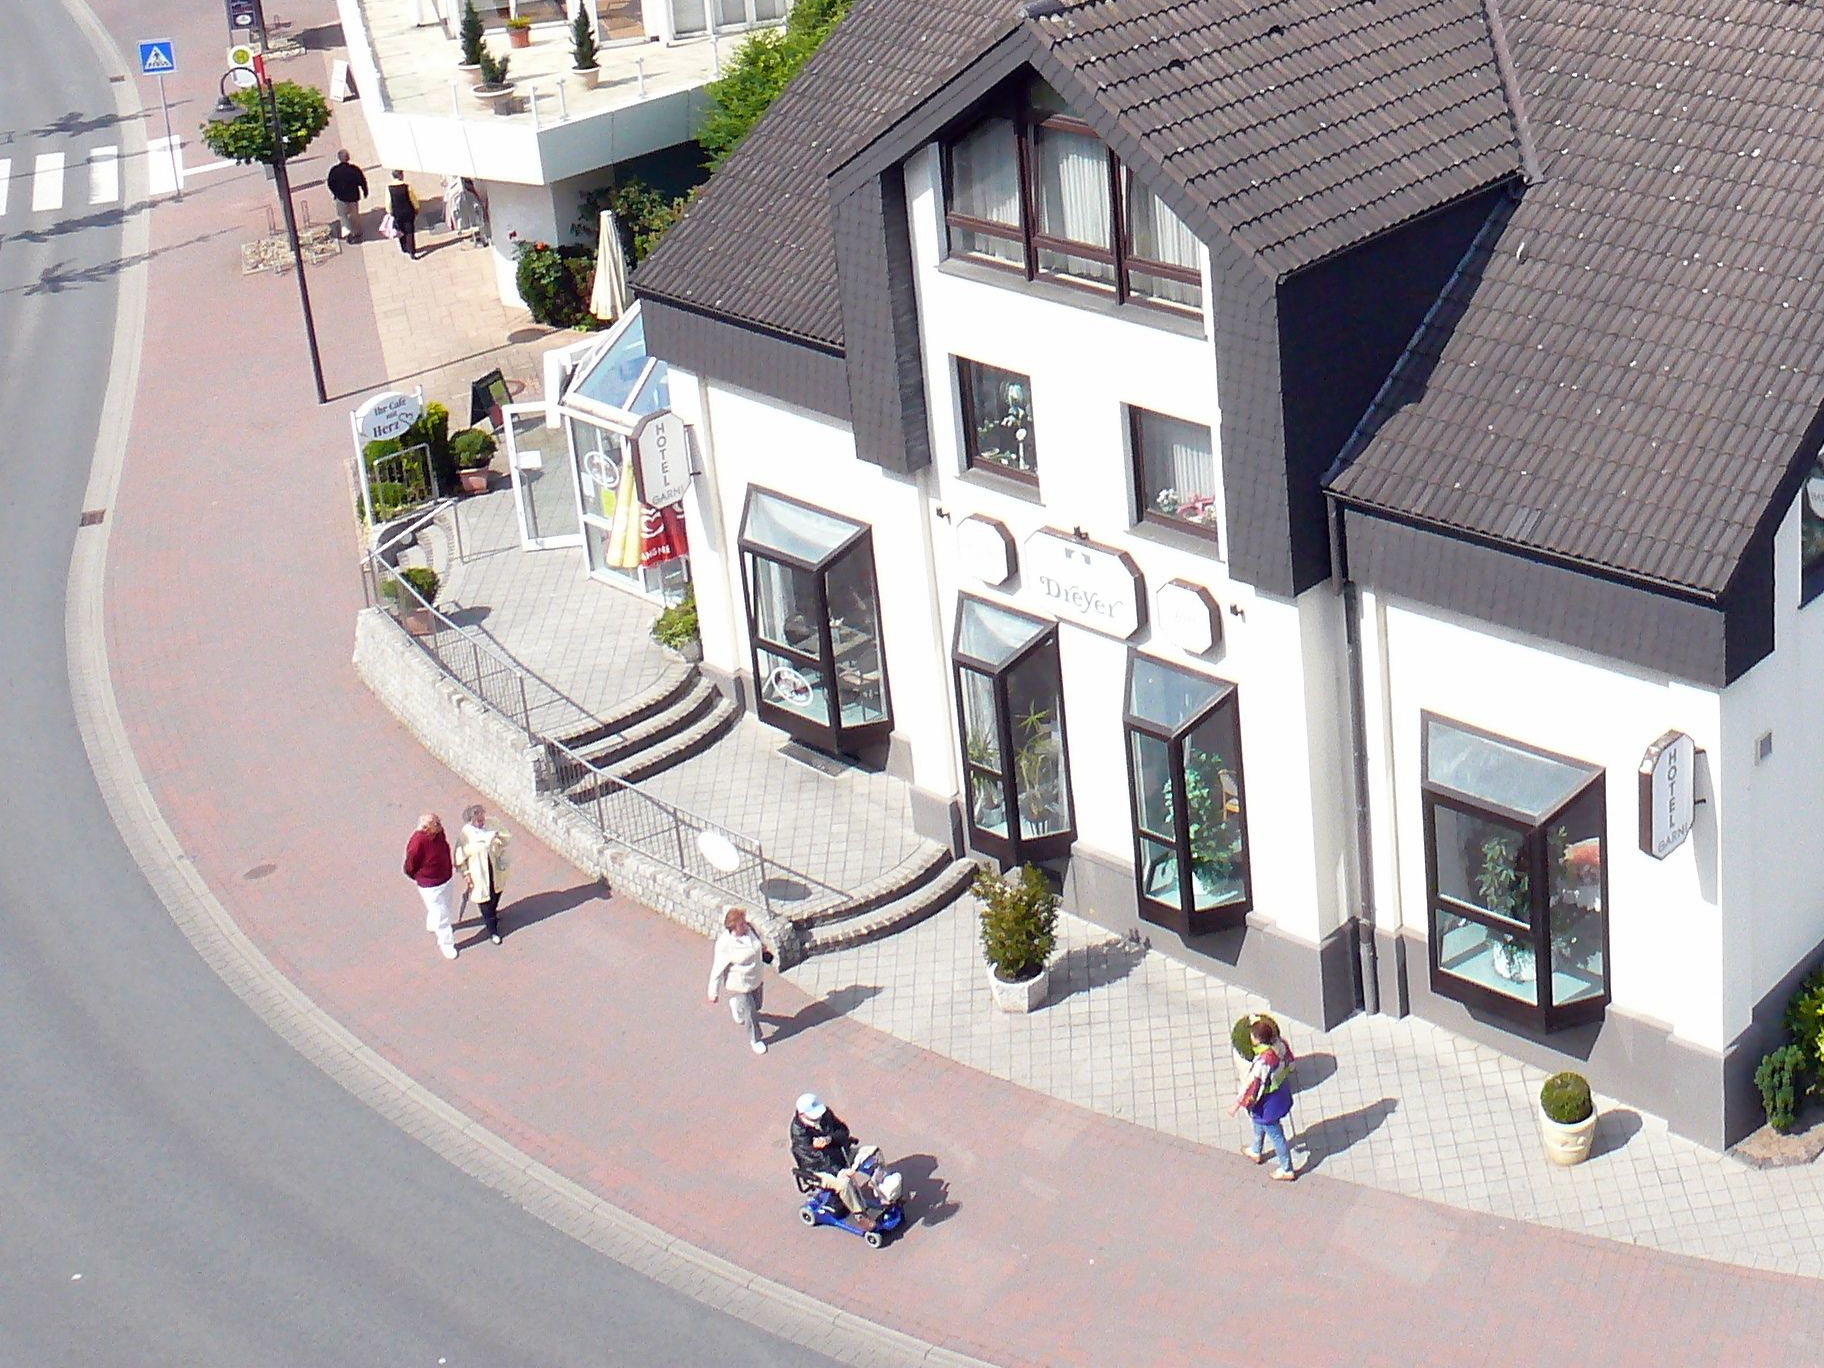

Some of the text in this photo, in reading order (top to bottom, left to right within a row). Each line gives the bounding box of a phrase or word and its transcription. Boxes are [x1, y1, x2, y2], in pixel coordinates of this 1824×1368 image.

[372, 421, 400, 438] Herz
[655, 422, 671, 487] HOTEL
[651, 484, 684, 507] GARNI
[1039, 575, 1124, 618] Dreyer
[1667, 747, 1678, 830] HOTEL
[1656, 820, 1694, 853] GARNI
